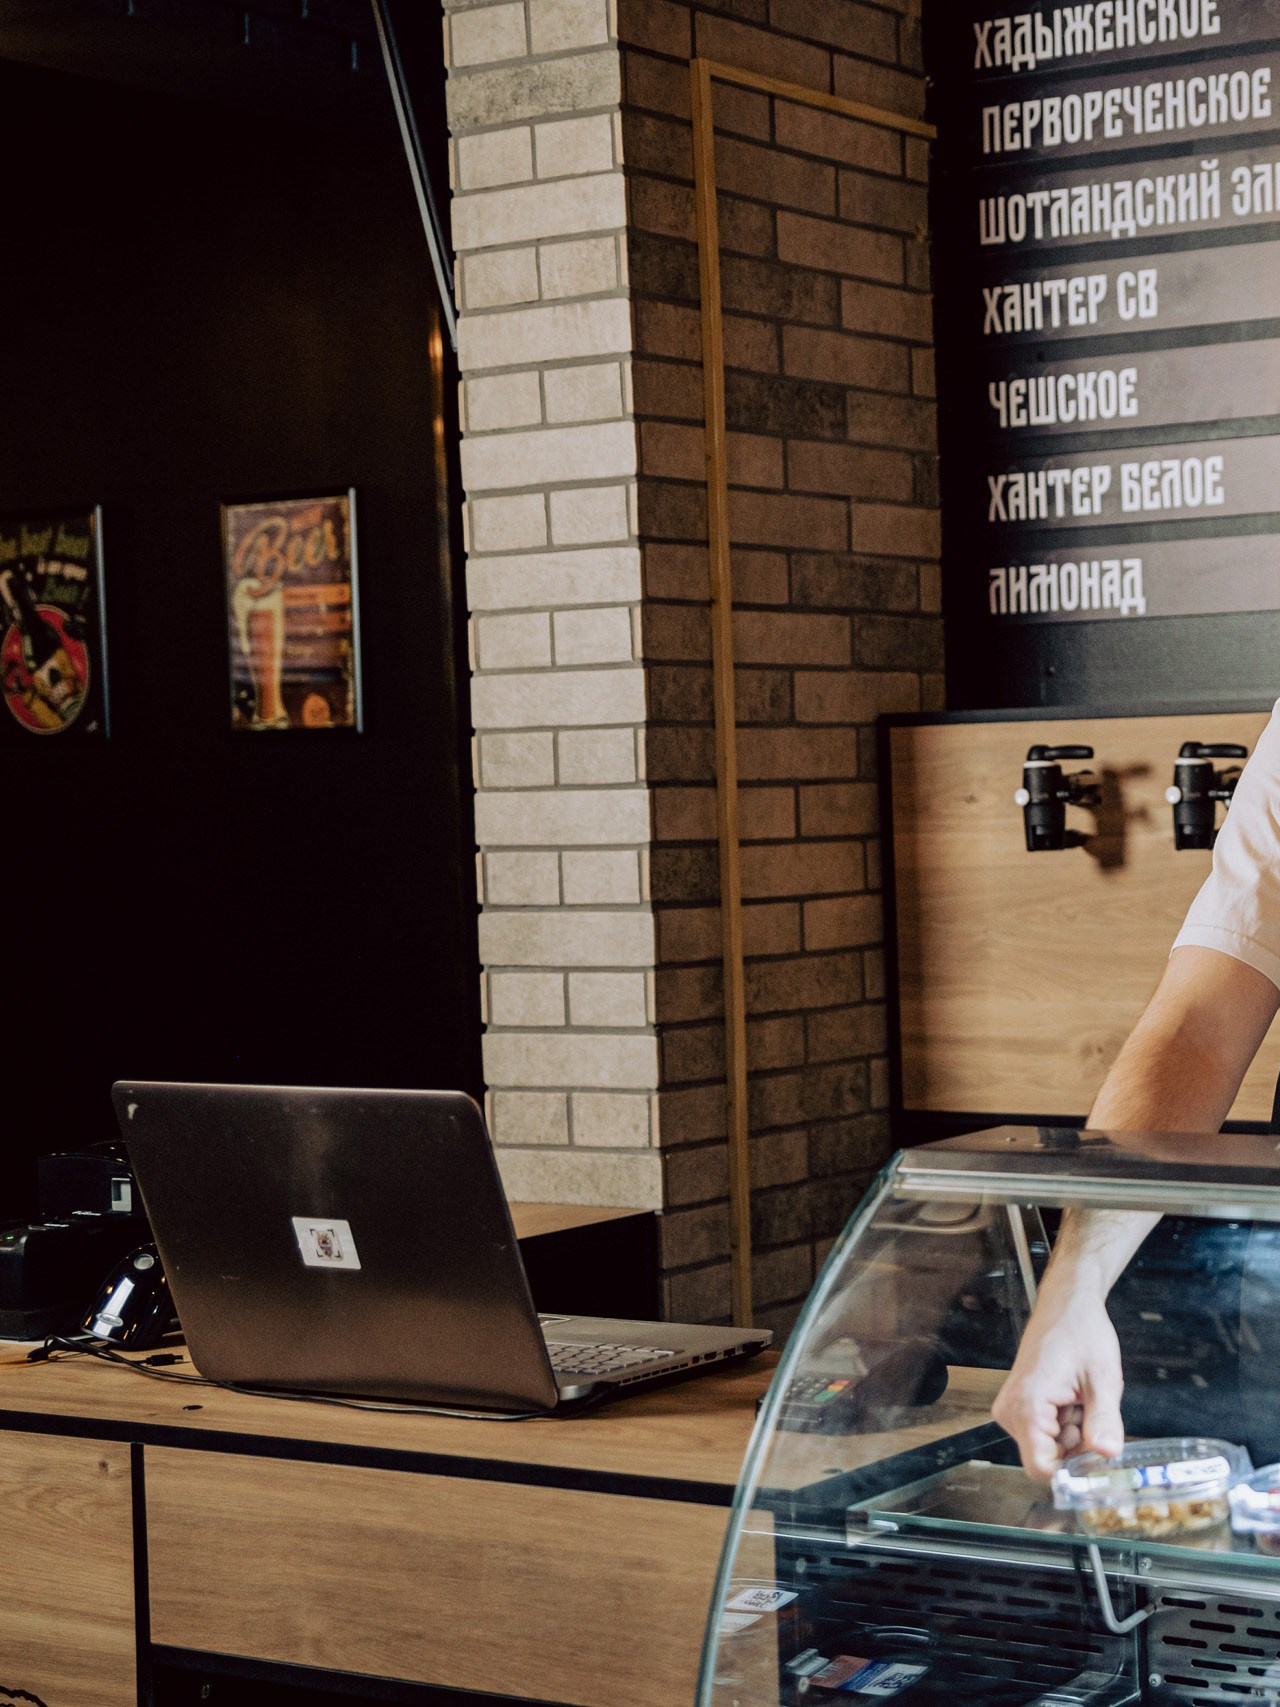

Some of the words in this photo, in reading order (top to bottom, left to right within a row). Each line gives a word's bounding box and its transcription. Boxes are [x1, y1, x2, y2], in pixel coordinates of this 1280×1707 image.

[973, 0, 1221, 72] ХАДЫЖЕНСКОЕ
[982, 67, 1272, 154] ПЕРВОРЕЧЕНСКОЕ
[979, 158, 1221, 245] ШОТЛАНДСКИЙ
[983, 274, 1108, 335] ХАНТЕР
[1116, 268, 1159, 321] СВ
[989, 367, 1139, 428] ЧЕШСКОЕ
[987, 465, 1112, 522] ХАНТЕР
[1120, 455, 1225, 513] БЕЛОЕ
[989, 558, 1147, 616] ЛИМОНАД
